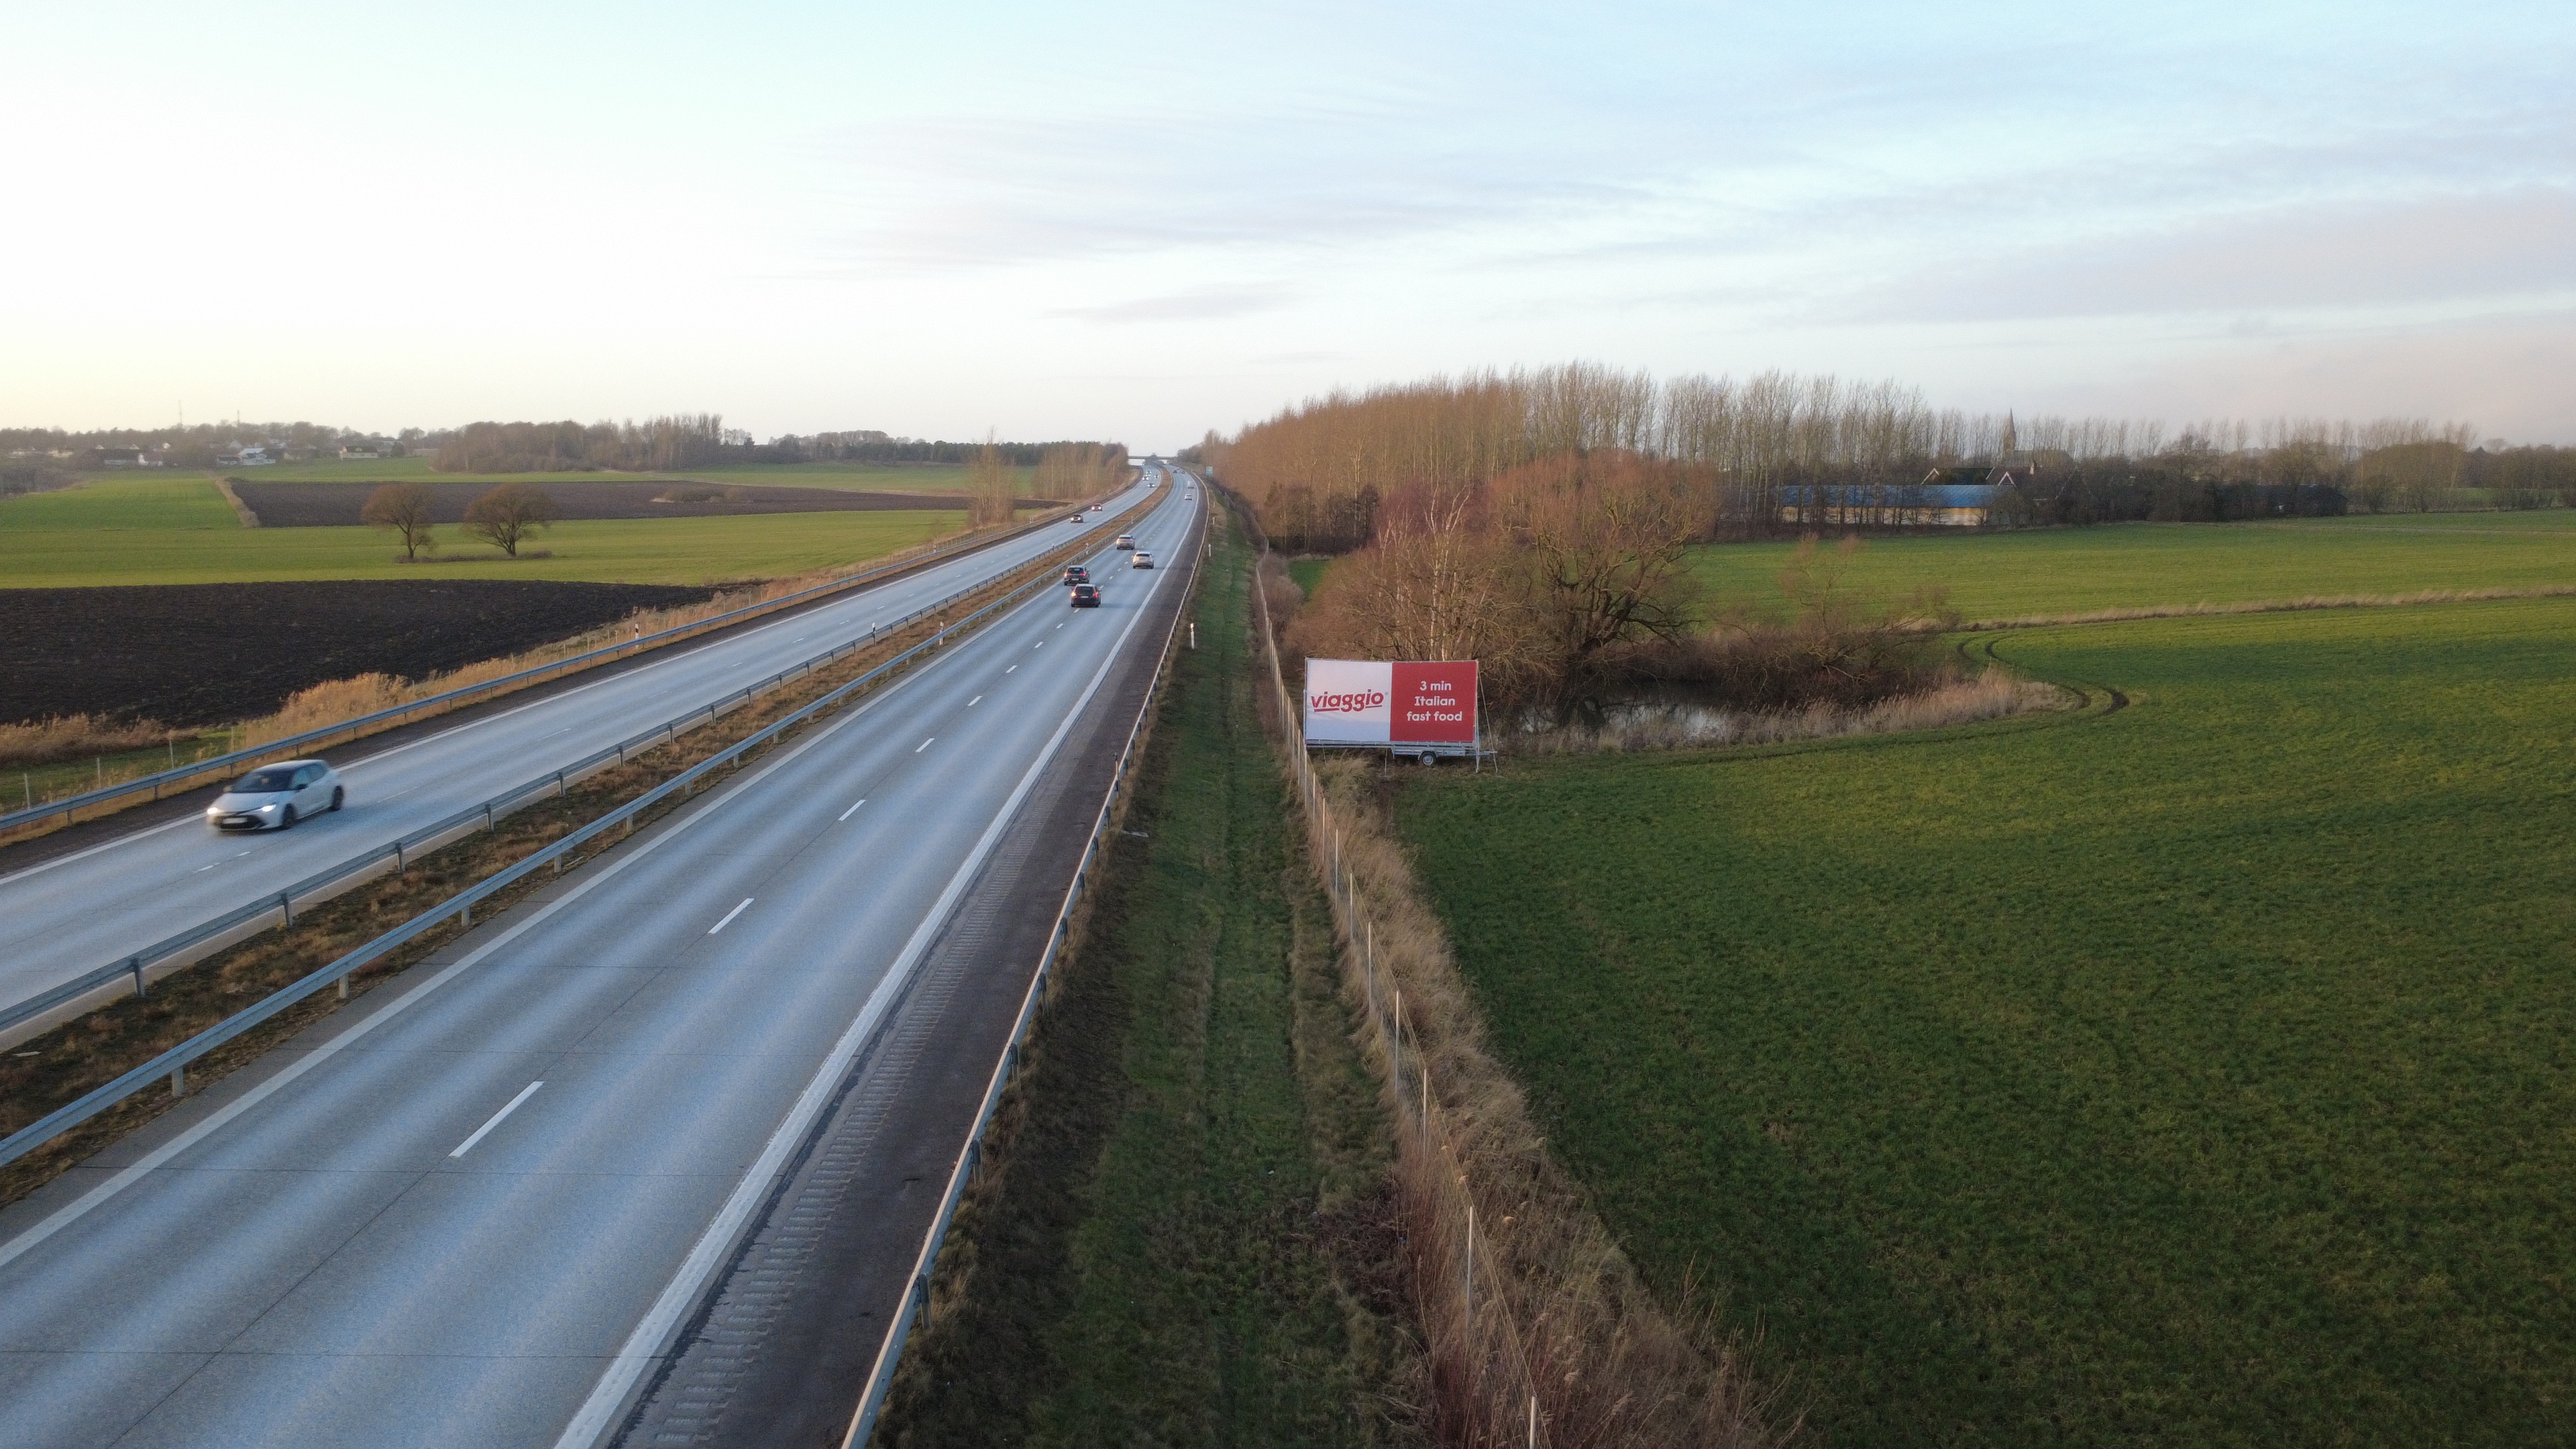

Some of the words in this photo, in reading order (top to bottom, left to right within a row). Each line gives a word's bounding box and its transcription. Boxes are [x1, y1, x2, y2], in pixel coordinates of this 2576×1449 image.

[1419, 681, 1427, 691] 3
[1430, 680, 1452, 691] min
[1311, 689, 1384, 712] viaggio
[1414, 695, 1456, 706] Italian
[1407, 711, 1431, 722] fast
[1434, 711, 1462, 722] food
